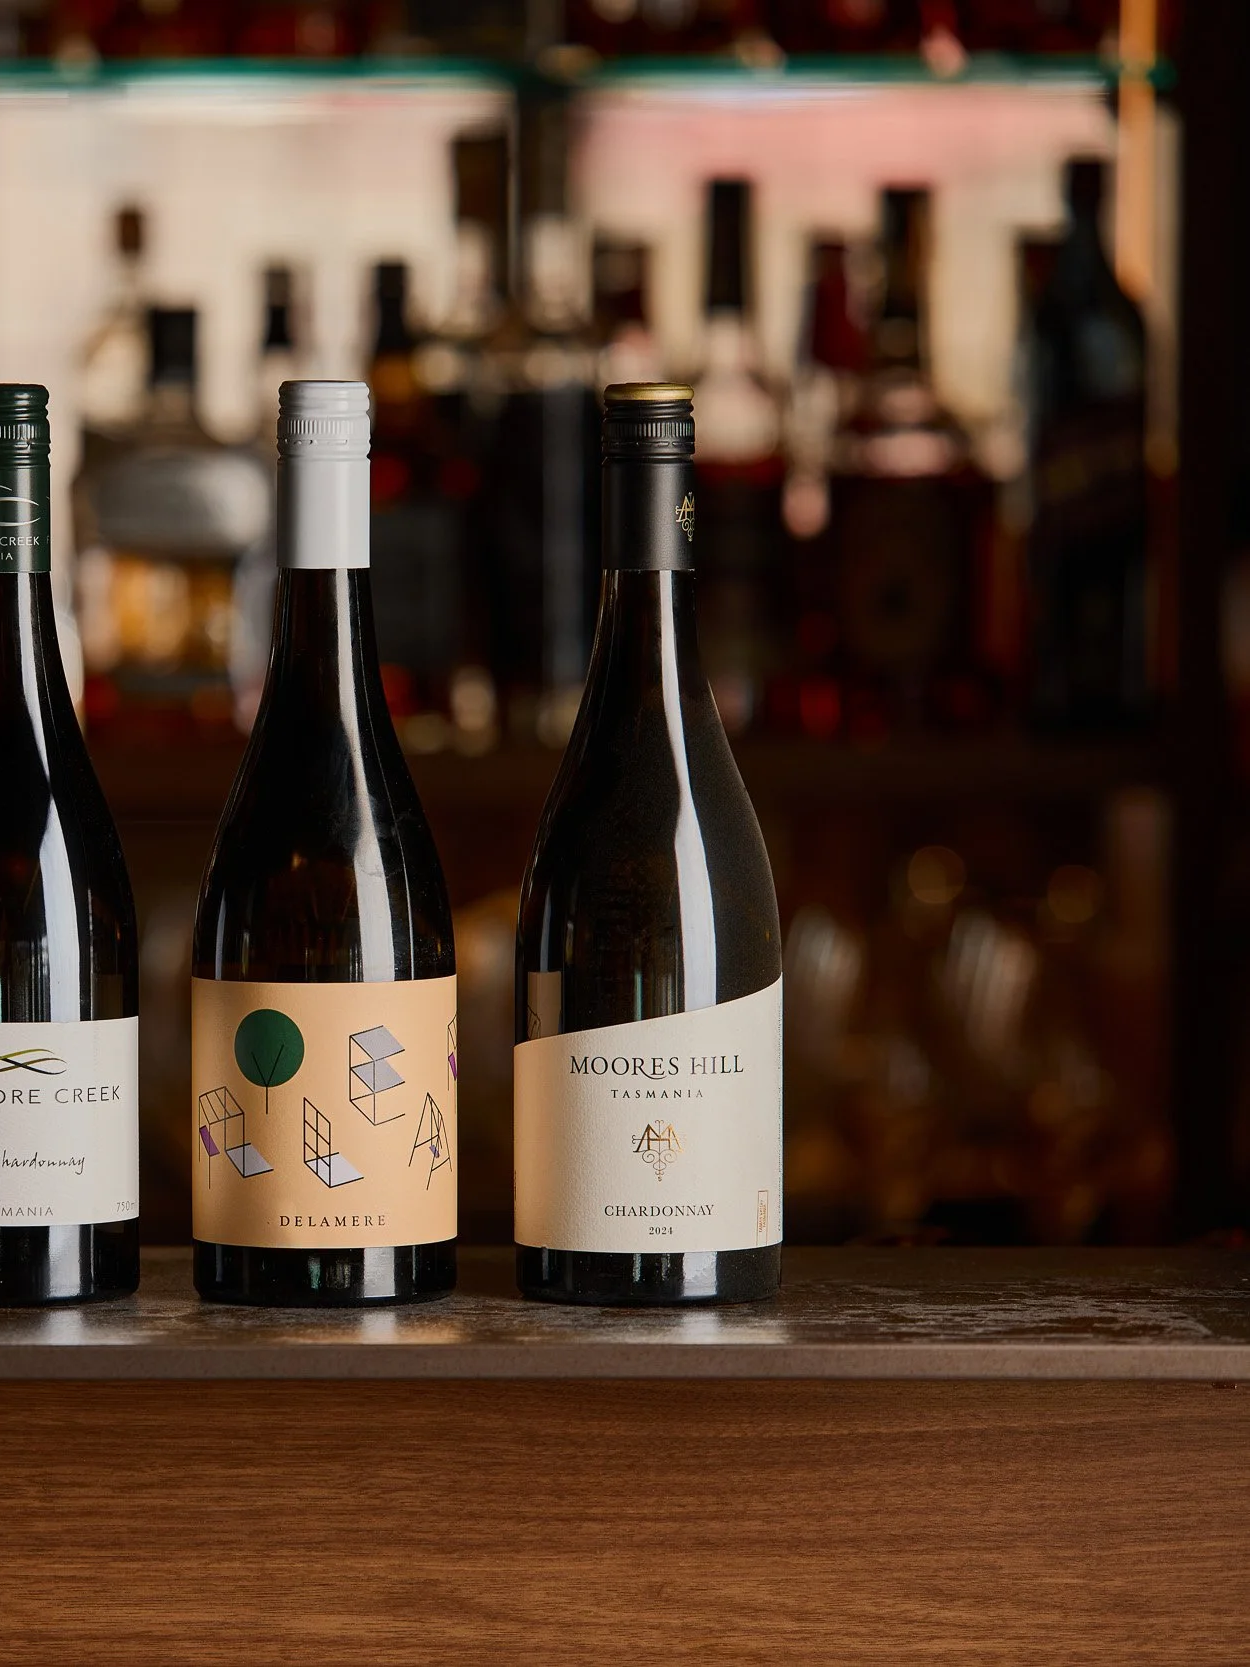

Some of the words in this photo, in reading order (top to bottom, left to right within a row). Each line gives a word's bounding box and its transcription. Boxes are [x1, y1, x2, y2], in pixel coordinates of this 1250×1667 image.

[569, 1054, 680, 1080] MOORES
[690, 1054, 744, 1075] HILL
[54, 1084, 121, 1104] CREEK
[610, 1088, 704, 1099] TASMANIA
[603, 1204, 715, 1217] CHARDONNAY
[279, 1214, 387, 1227] DELAMERE
[648, 1225, 674, 1236] 2024
